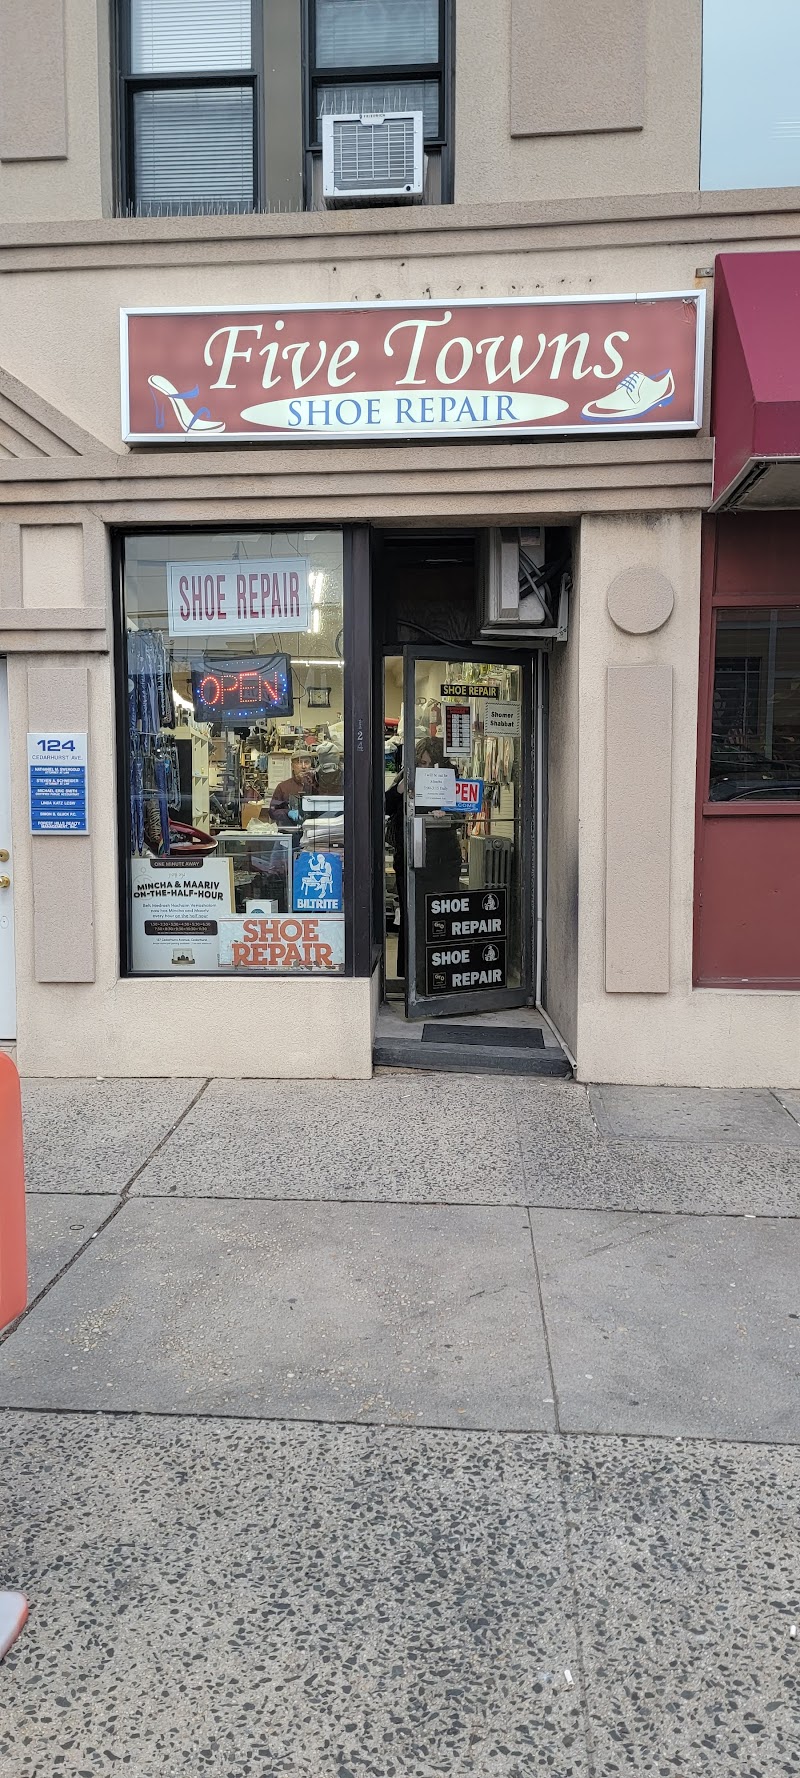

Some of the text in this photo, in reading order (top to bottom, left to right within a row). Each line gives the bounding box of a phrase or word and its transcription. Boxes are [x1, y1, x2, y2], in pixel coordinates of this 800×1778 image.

[203, 311, 629, 390] Five Towns
[287, 394, 520, 427] SHOE REPAIR
[179, 572, 300, 621] SHOE REPAIR
[201, 672, 278, 705] OPEN
[444, 686, 497, 697] SHOE REPAIR
[37, 740, 76, 752] 124
[456, 783, 478, 801] PEN
[137, 882, 172, 890] MINCHA
[184, 881, 220, 890] MAARIV
[134, 890, 223, 900] ON-THE-HALF-HOUR
[297, 899, 338, 909] BILTRITE
[431, 898, 470, 914] SHOE
[243, 920, 319, 942] SHOE
[452, 919, 501, 935] REPAIR
[232, 943, 333, 966] REPAIR
[432, 950, 470, 966] SHOE
[452, 969, 502, 987] REPAIR
